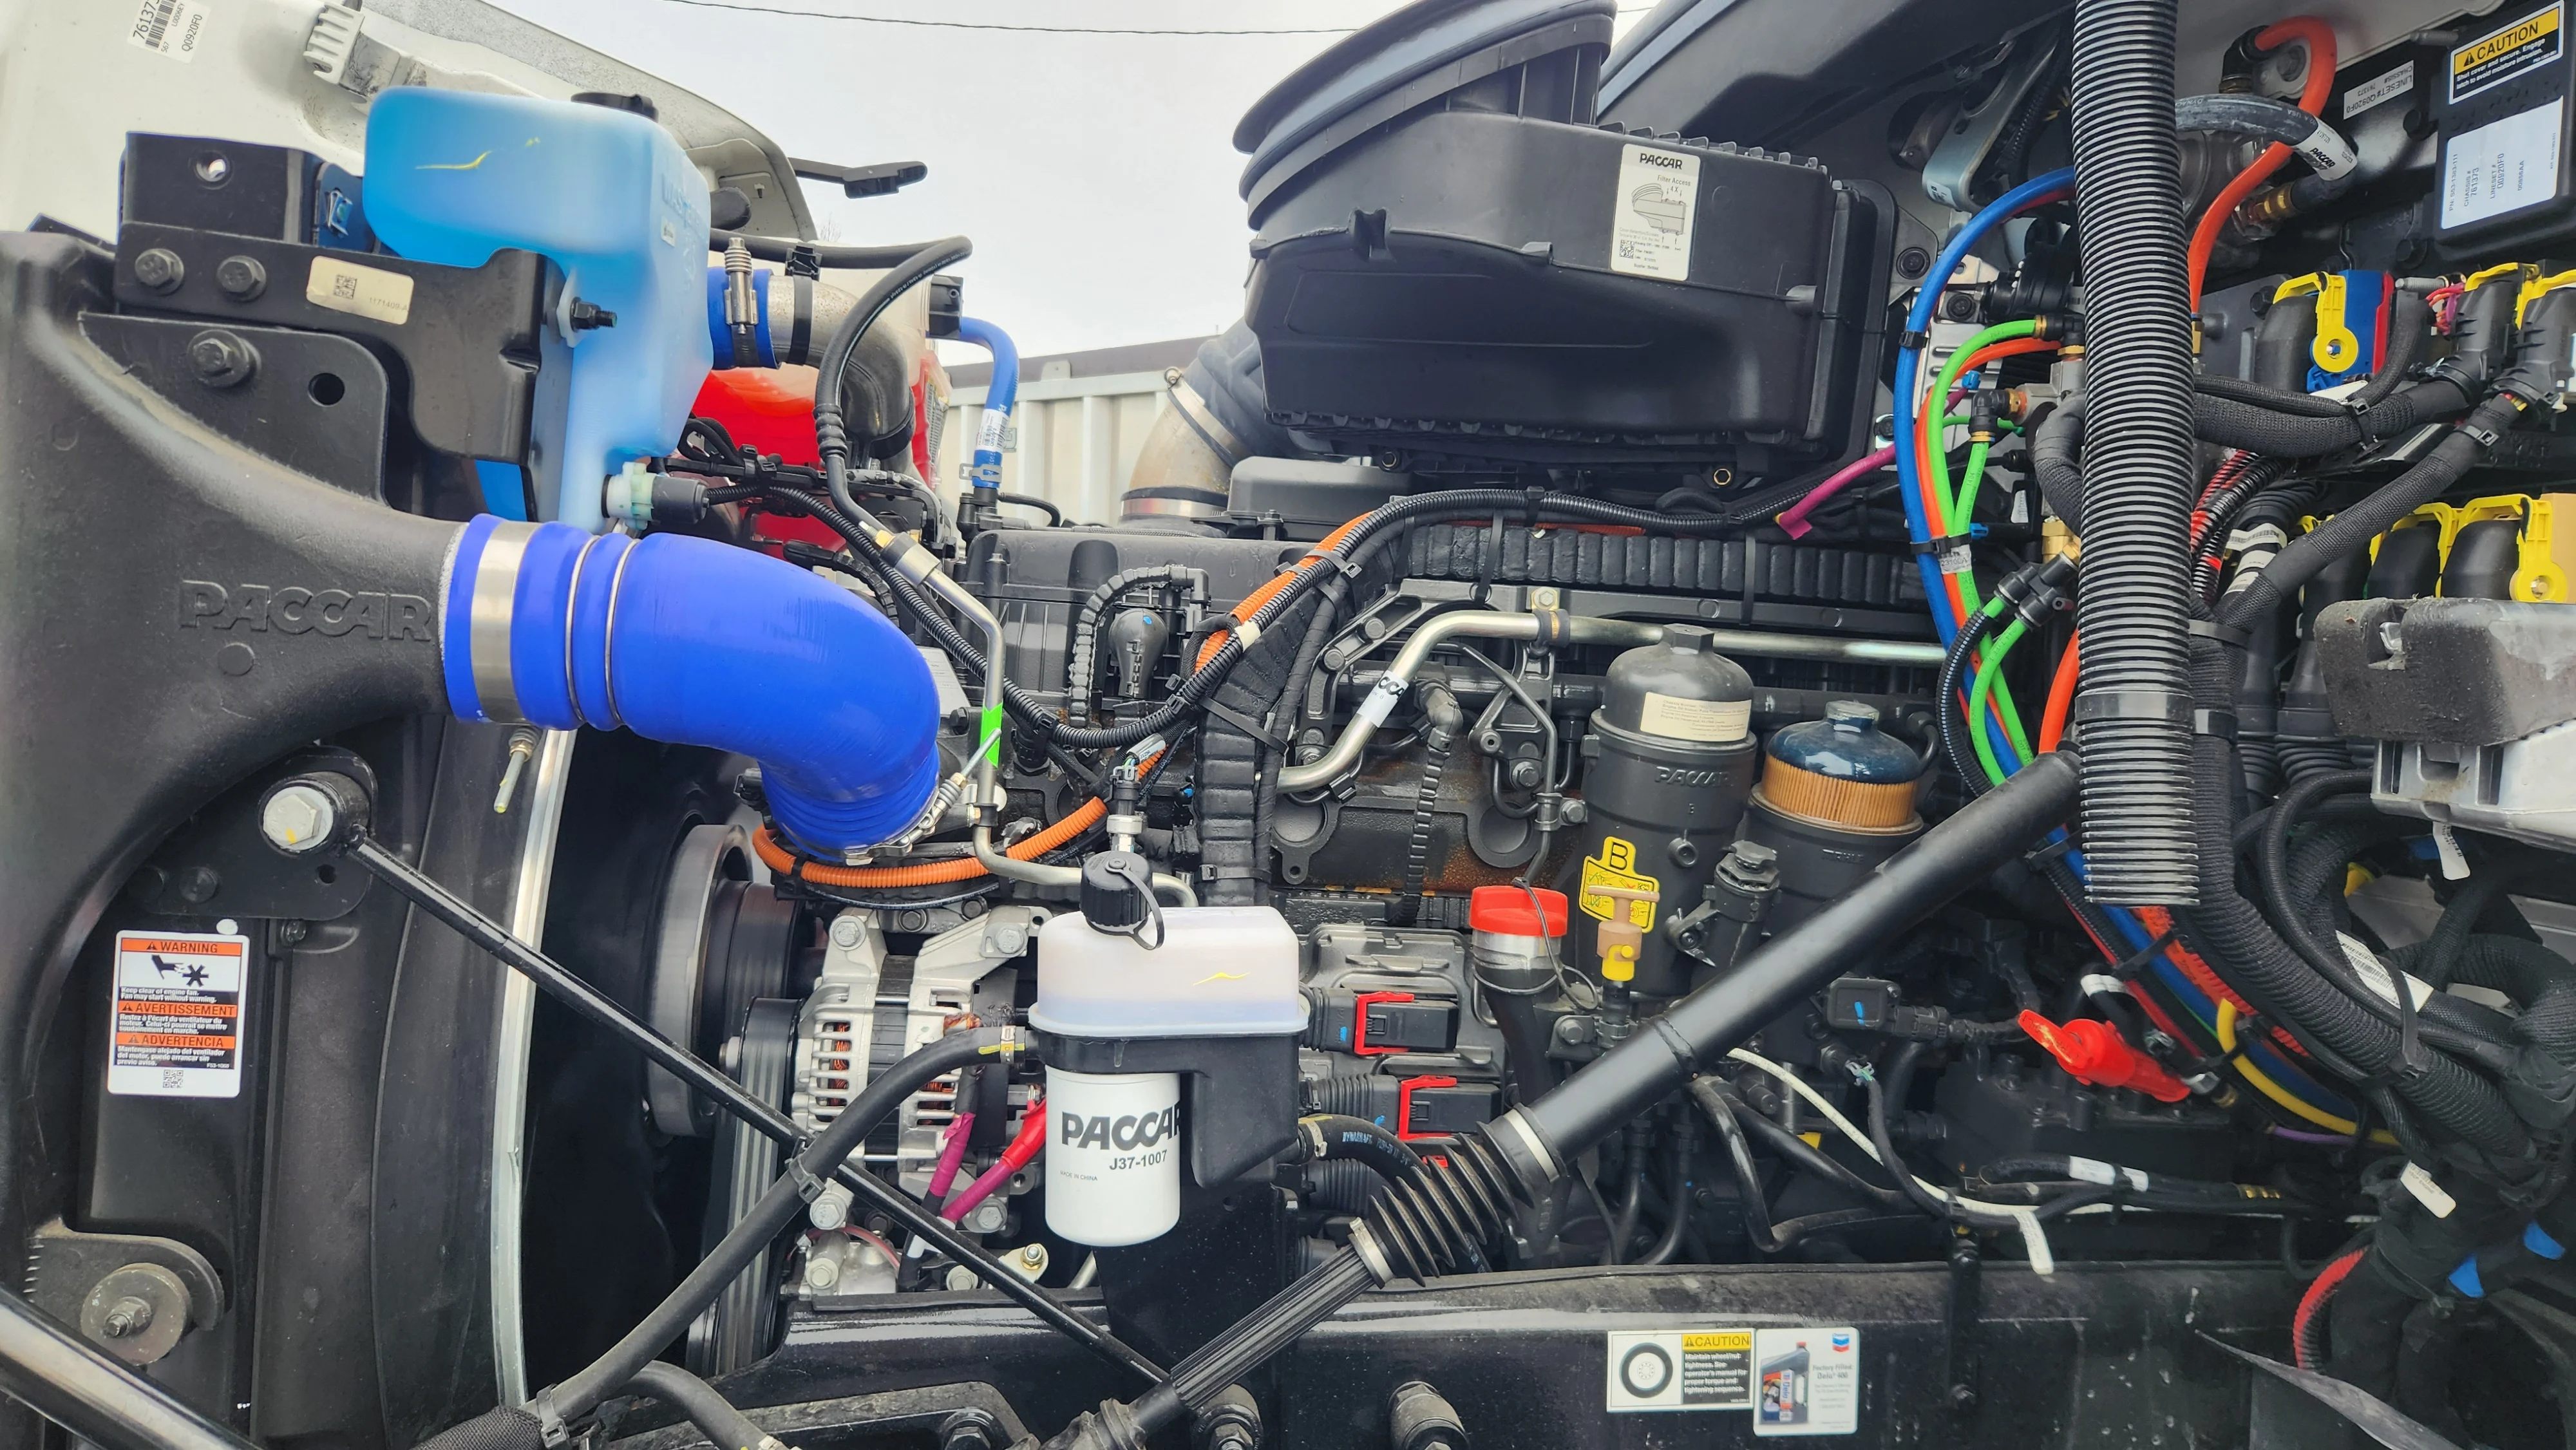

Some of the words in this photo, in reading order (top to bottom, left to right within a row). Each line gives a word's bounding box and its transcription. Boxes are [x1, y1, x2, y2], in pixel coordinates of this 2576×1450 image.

[182, 14, 203, 52] Q0920F0
[2477, 21, 2538, 60] CAUTION
[161, 41, 169, 53] 567
[2456, 79, 2469, 89] latch
[2476, 70, 2491, 81] avoid
[2492, 60, 2516, 75] moisture
[2517, 48, 2543, 63] intrusion.
[2457, 71, 2470, 82] Shut
[2470, 64, 2487, 76] cover
[2487, 59, 2499, 69] and
[2499, 50, 2521, 62] secure.
[2523, 38, 2546, 52] Engage
[2384, 65, 2413, 84] CHASSIS#
[2376, 75, 2412, 97] LINESET#
[2346, 93, 2376, 113] Q0920F0
[1640, 153, 1683, 170] PACCAR
[2309, 147, 2336, 168] PACCAR
[1657, 174, 1671, 183] Filter
[1672, 178, 1690, 186] Access
[2470, 167, 2479, 197] 761373
[180, 579, 432, 642] PACCAR
[1609, 842, 1628, 871] B
[160, 941, 218, 953] WARNING
[136, 1003, 234, 1015] AVERTISSEMENT
[142, 1035, 223, 1047] ADVERTENCIA
[193, 1048, 225, 1057] ventilador
[1109, 1149, 1168, 1171] J37-1007
[1060, 1170, 1073, 1178] MADE
[1695, 1335, 1750, 1347] CAUTION
[1684, 1361, 1714, 1370] tightness.
[1684, 1369, 1715, 1378] operator's
[1684, 1378, 1705, 1386] proper
[1705, 1377, 1725, 1386] torque
[1684, 1386, 1714, 1394] tightening
[1714, 1386, 1746, 1394] sequence.
